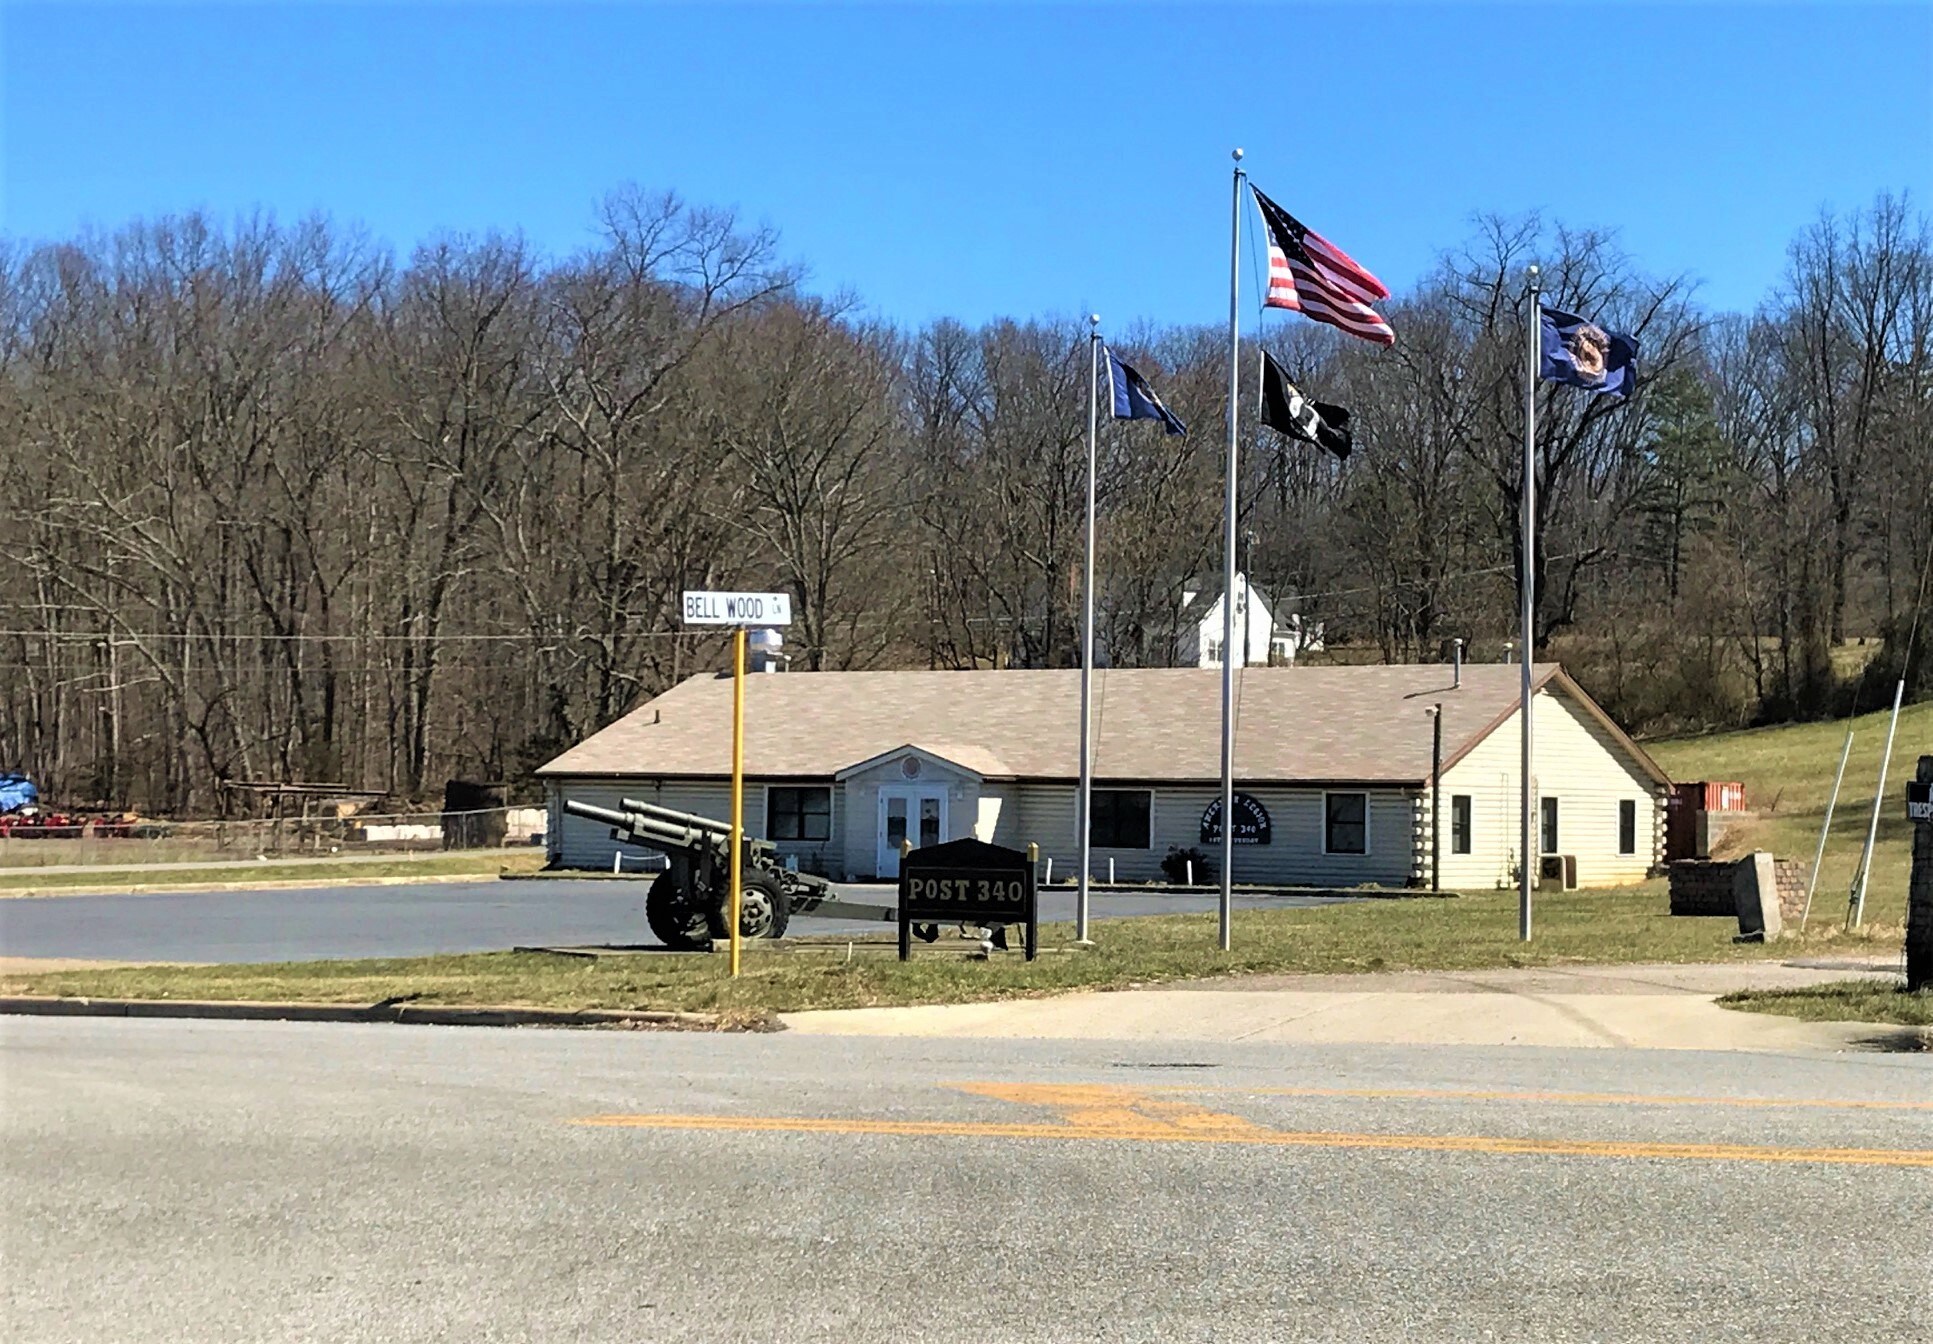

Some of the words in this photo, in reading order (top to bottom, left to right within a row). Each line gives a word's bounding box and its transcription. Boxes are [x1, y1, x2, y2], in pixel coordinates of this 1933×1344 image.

[686, 596, 720, 618] BELL
[726, 597, 763, 618] WOOD
[1203, 795, 1239, 830] AMERN
[1243, 799, 1267, 830] LEGION
[1241, 825, 1256, 833] 340
[908, 878, 970, 901] POST
[978, 880, 1023, 902] 340
